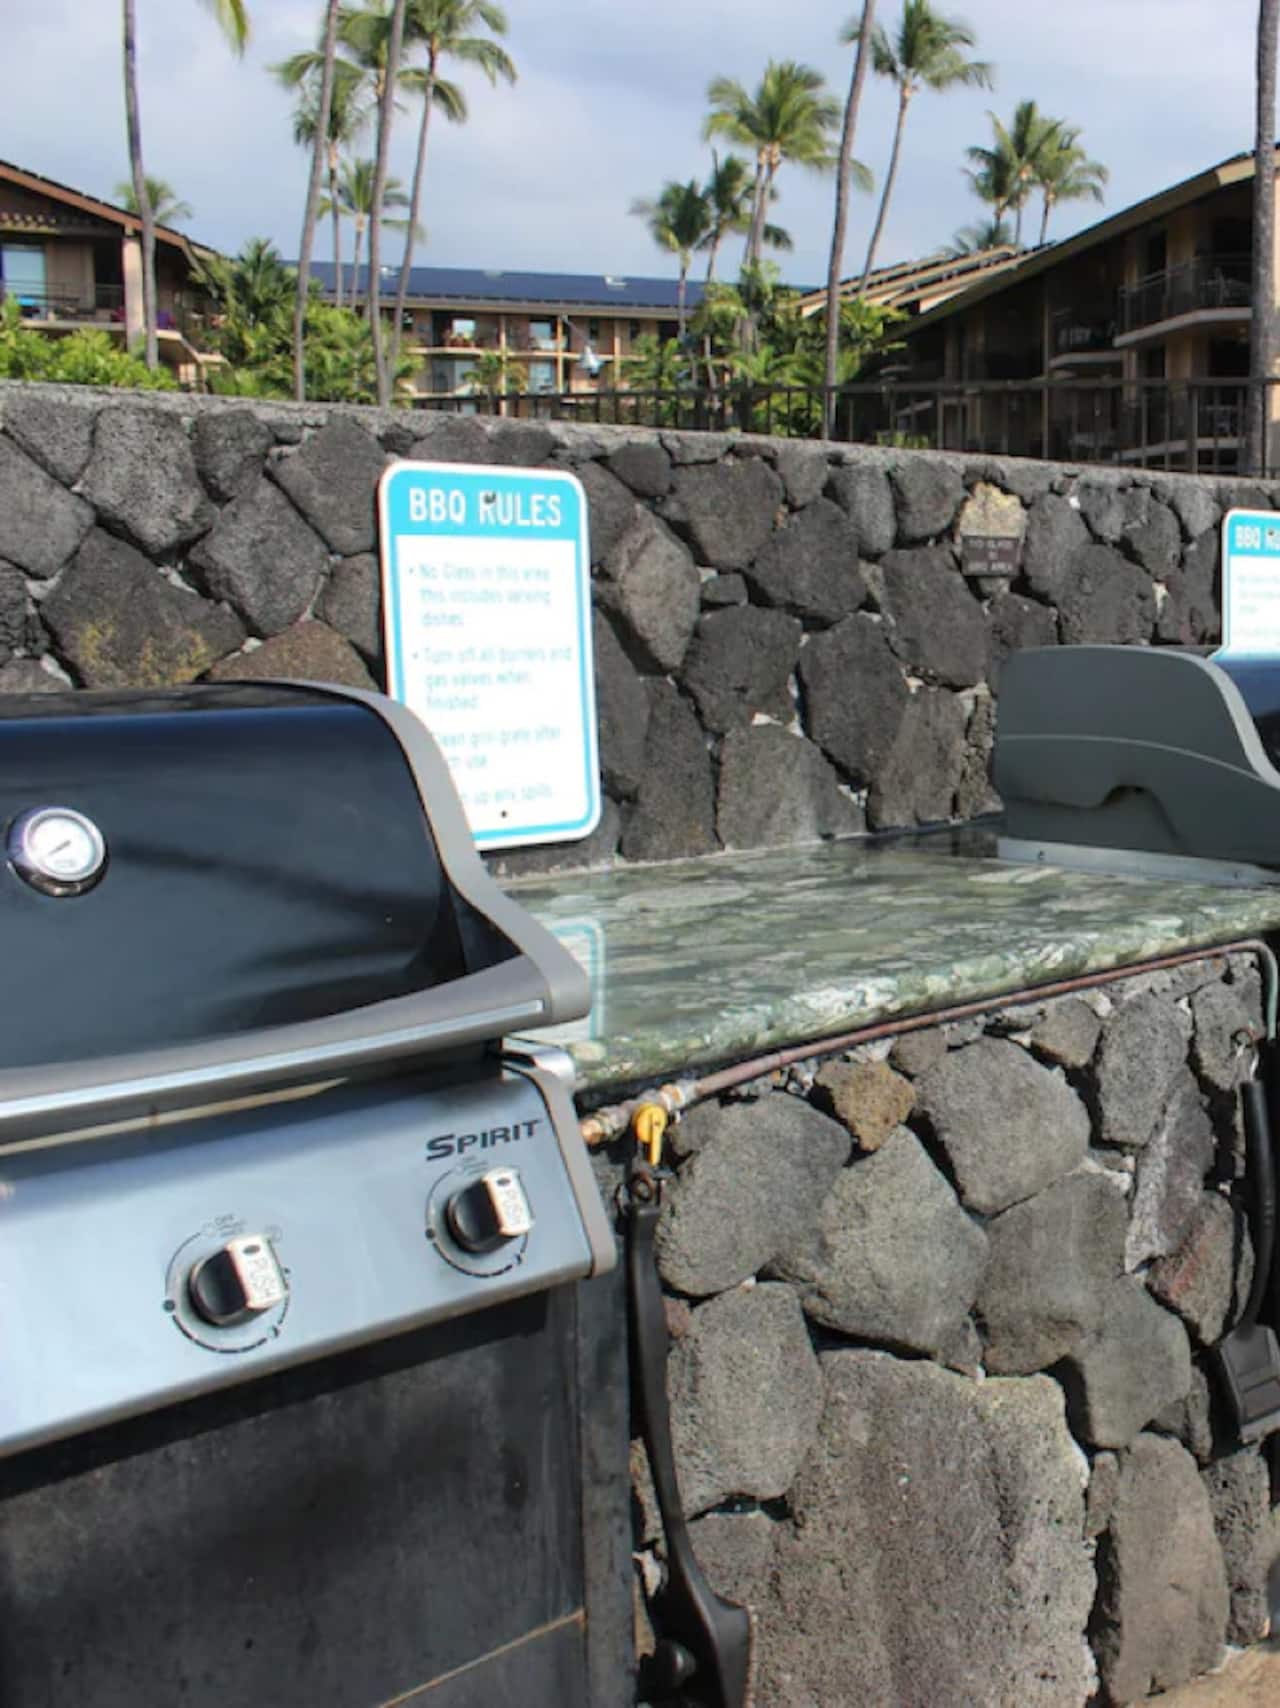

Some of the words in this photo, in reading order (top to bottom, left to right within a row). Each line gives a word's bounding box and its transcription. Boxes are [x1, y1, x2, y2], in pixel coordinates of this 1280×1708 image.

[409, 487, 466, 522] BBQ
[478, 490, 561, 526] RULES
[1235, 525, 1260, 550] BBQ
[426, 1119, 542, 1162] SPIRIT
